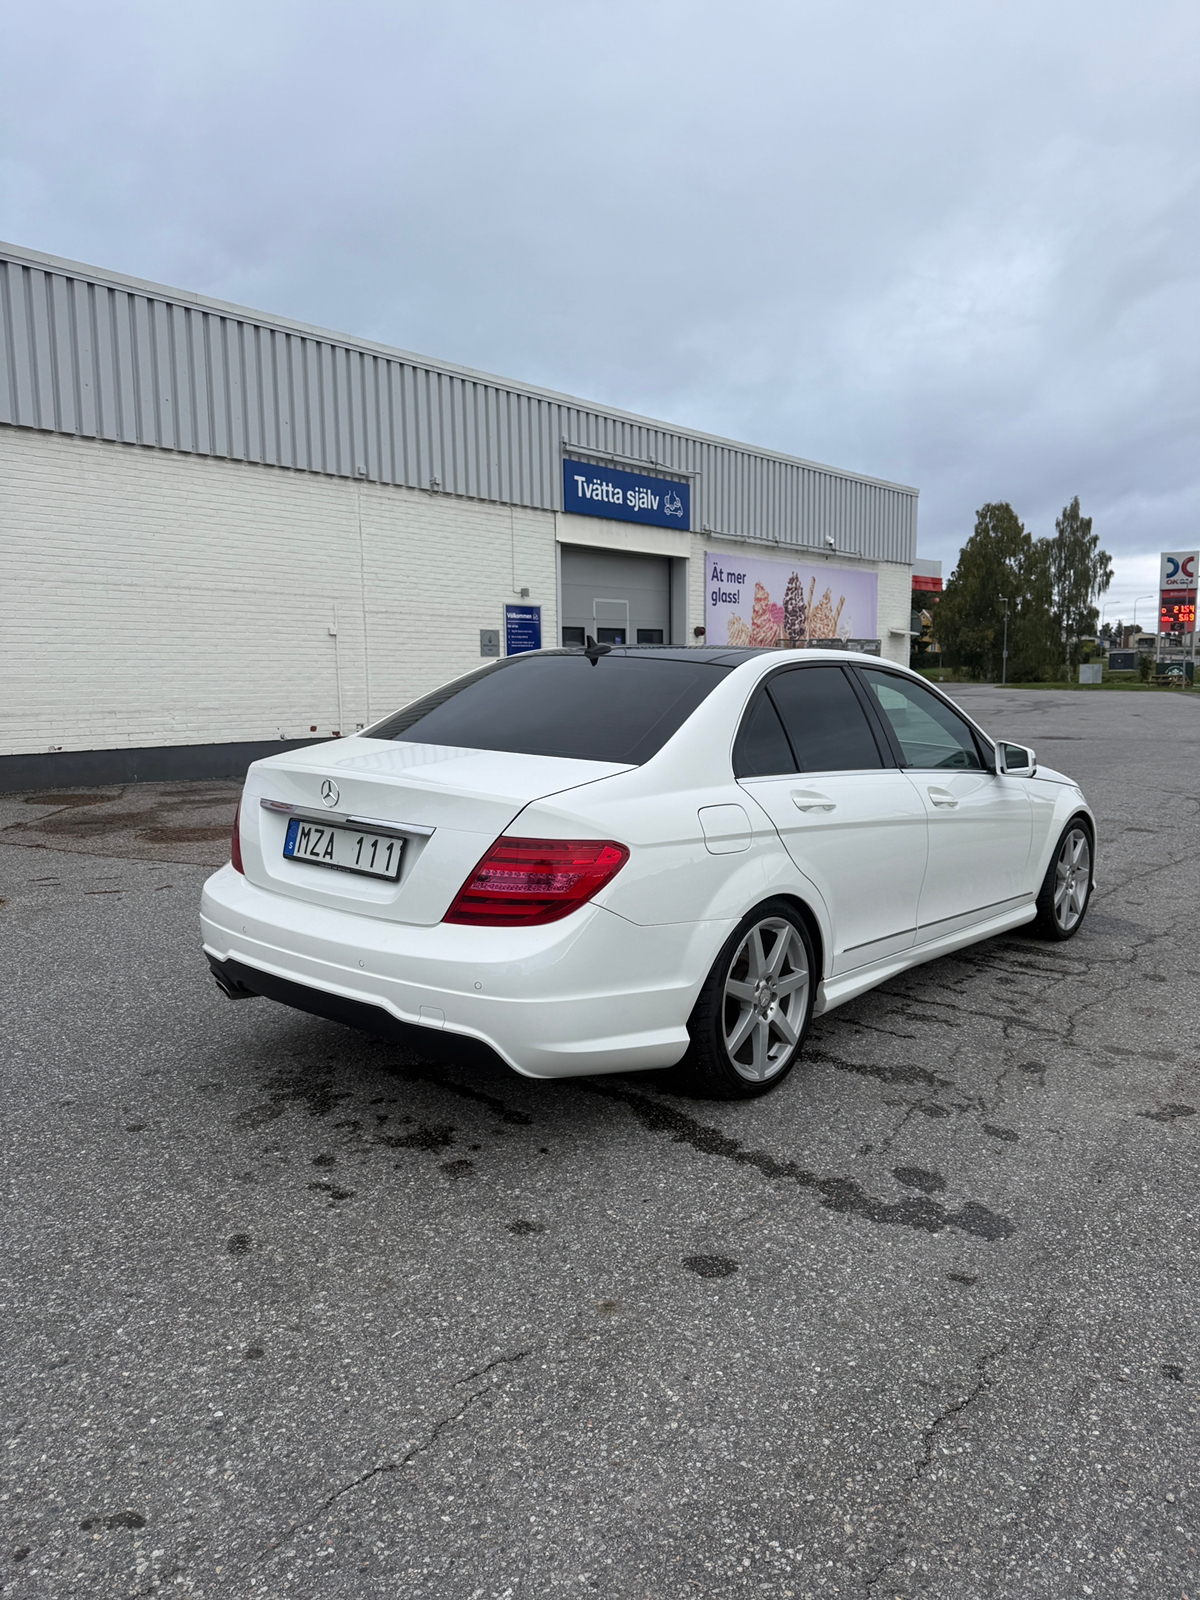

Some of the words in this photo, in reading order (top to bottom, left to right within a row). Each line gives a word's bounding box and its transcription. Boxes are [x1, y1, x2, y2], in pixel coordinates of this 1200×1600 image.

[574, 475, 623, 504] Tvätta
[626, 487, 660, 511] själv
[711, 562, 724, 583] Ät
[727, 572, 747, 585] mer
[711, 588, 740, 606] glass!
[288, 841, 294, 849] S
[297, 826, 335, 860] MZA
[356, 836, 394, 871] 111
